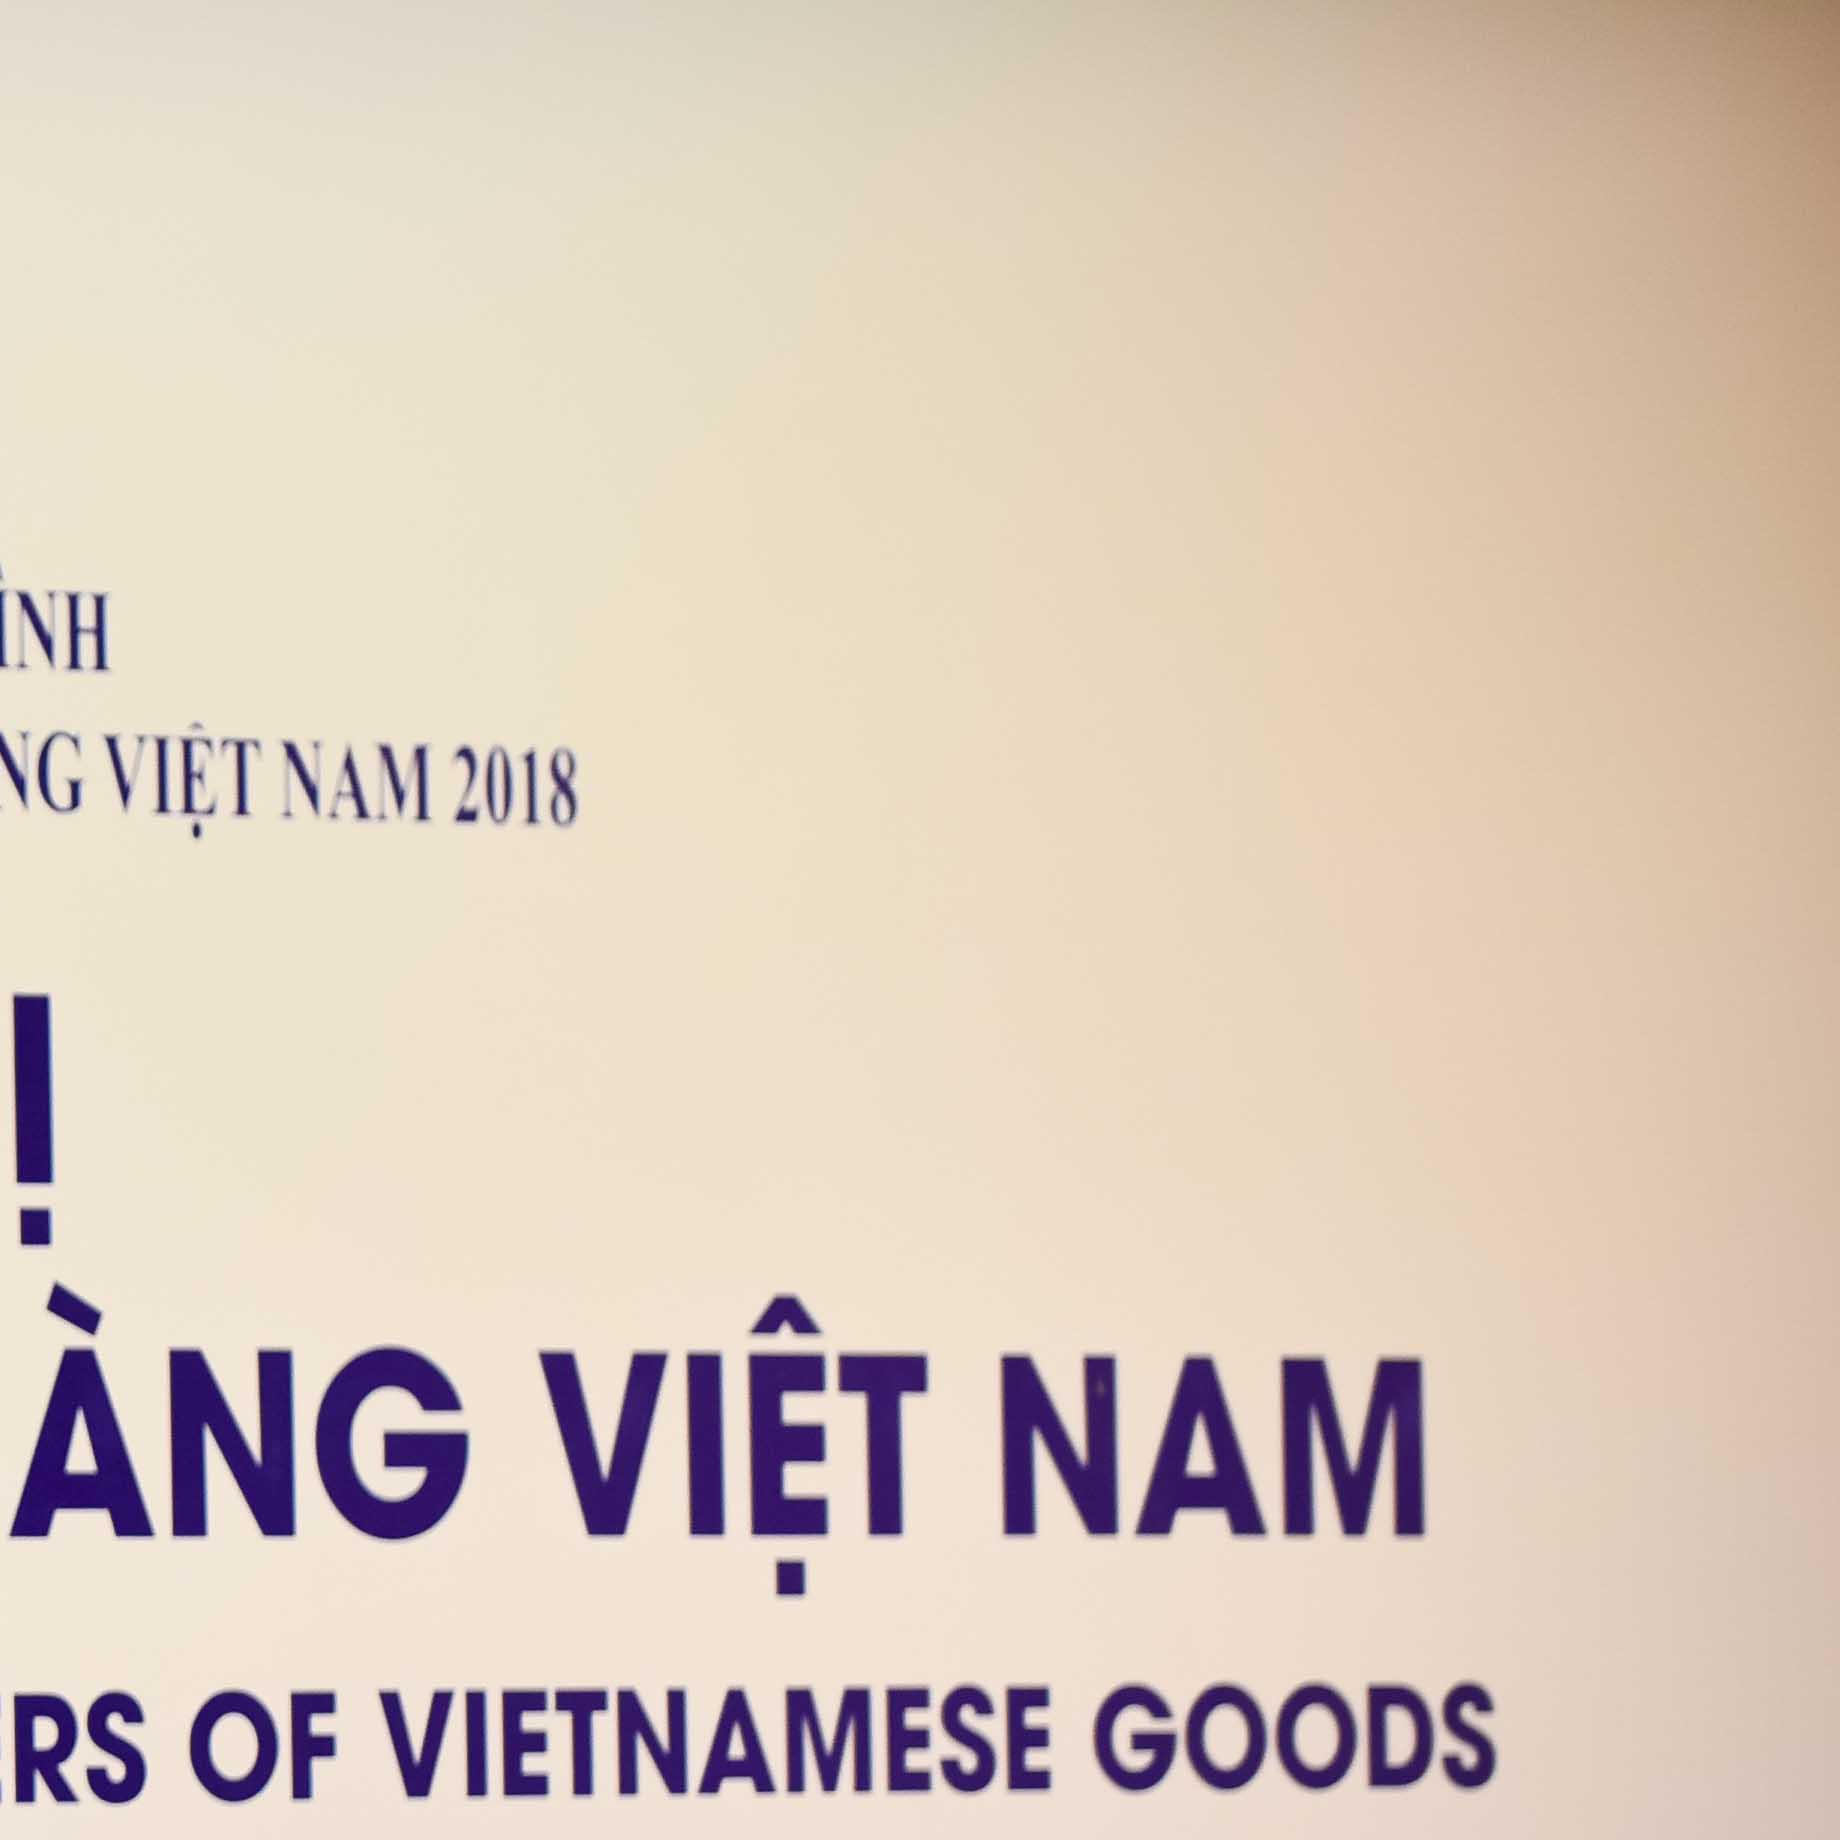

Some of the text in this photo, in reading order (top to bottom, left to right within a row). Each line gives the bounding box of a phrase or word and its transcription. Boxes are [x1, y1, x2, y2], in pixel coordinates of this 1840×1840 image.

[105, 724, 259, 838] VIỆT
[283, 741, 429, 821] NAM
[455, 746, 576, 825] 2018
[539, 1296, 928, 1596] VIỆT
[1001, 1355, 1425, 1537] NAM
[190, 1691, 336, 1802] OF
[379, 1685, 1051, 1798] VIETNAMESE
[1094, 1683, 1496, 1792] GOODS
